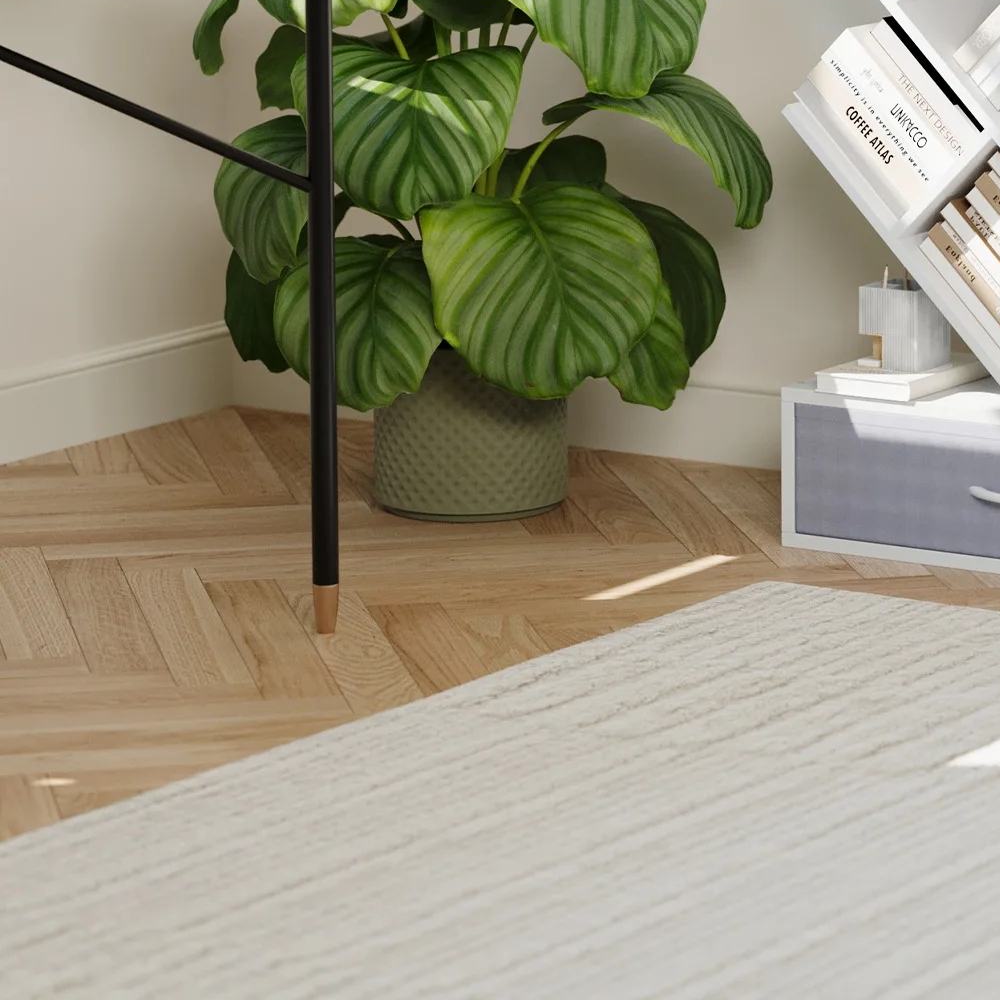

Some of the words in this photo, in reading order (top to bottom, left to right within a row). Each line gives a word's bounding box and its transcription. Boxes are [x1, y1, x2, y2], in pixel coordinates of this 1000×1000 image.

[830, 60, 861, 97] simplicity
[860, 97, 868, 105] is
[867, 106, 875, 115] in
[875, 116, 909, 156] everything
[908, 156, 918, 167] we
[918, 169, 929, 182] see
[846, 106, 873, 138] COFFEE
[869, 136, 894, 164] ATLAS
[898, 74, 915, 95] THE
[912, 93, 935, 119] NEXT
[933, 118, 965, 156] DESIGN
